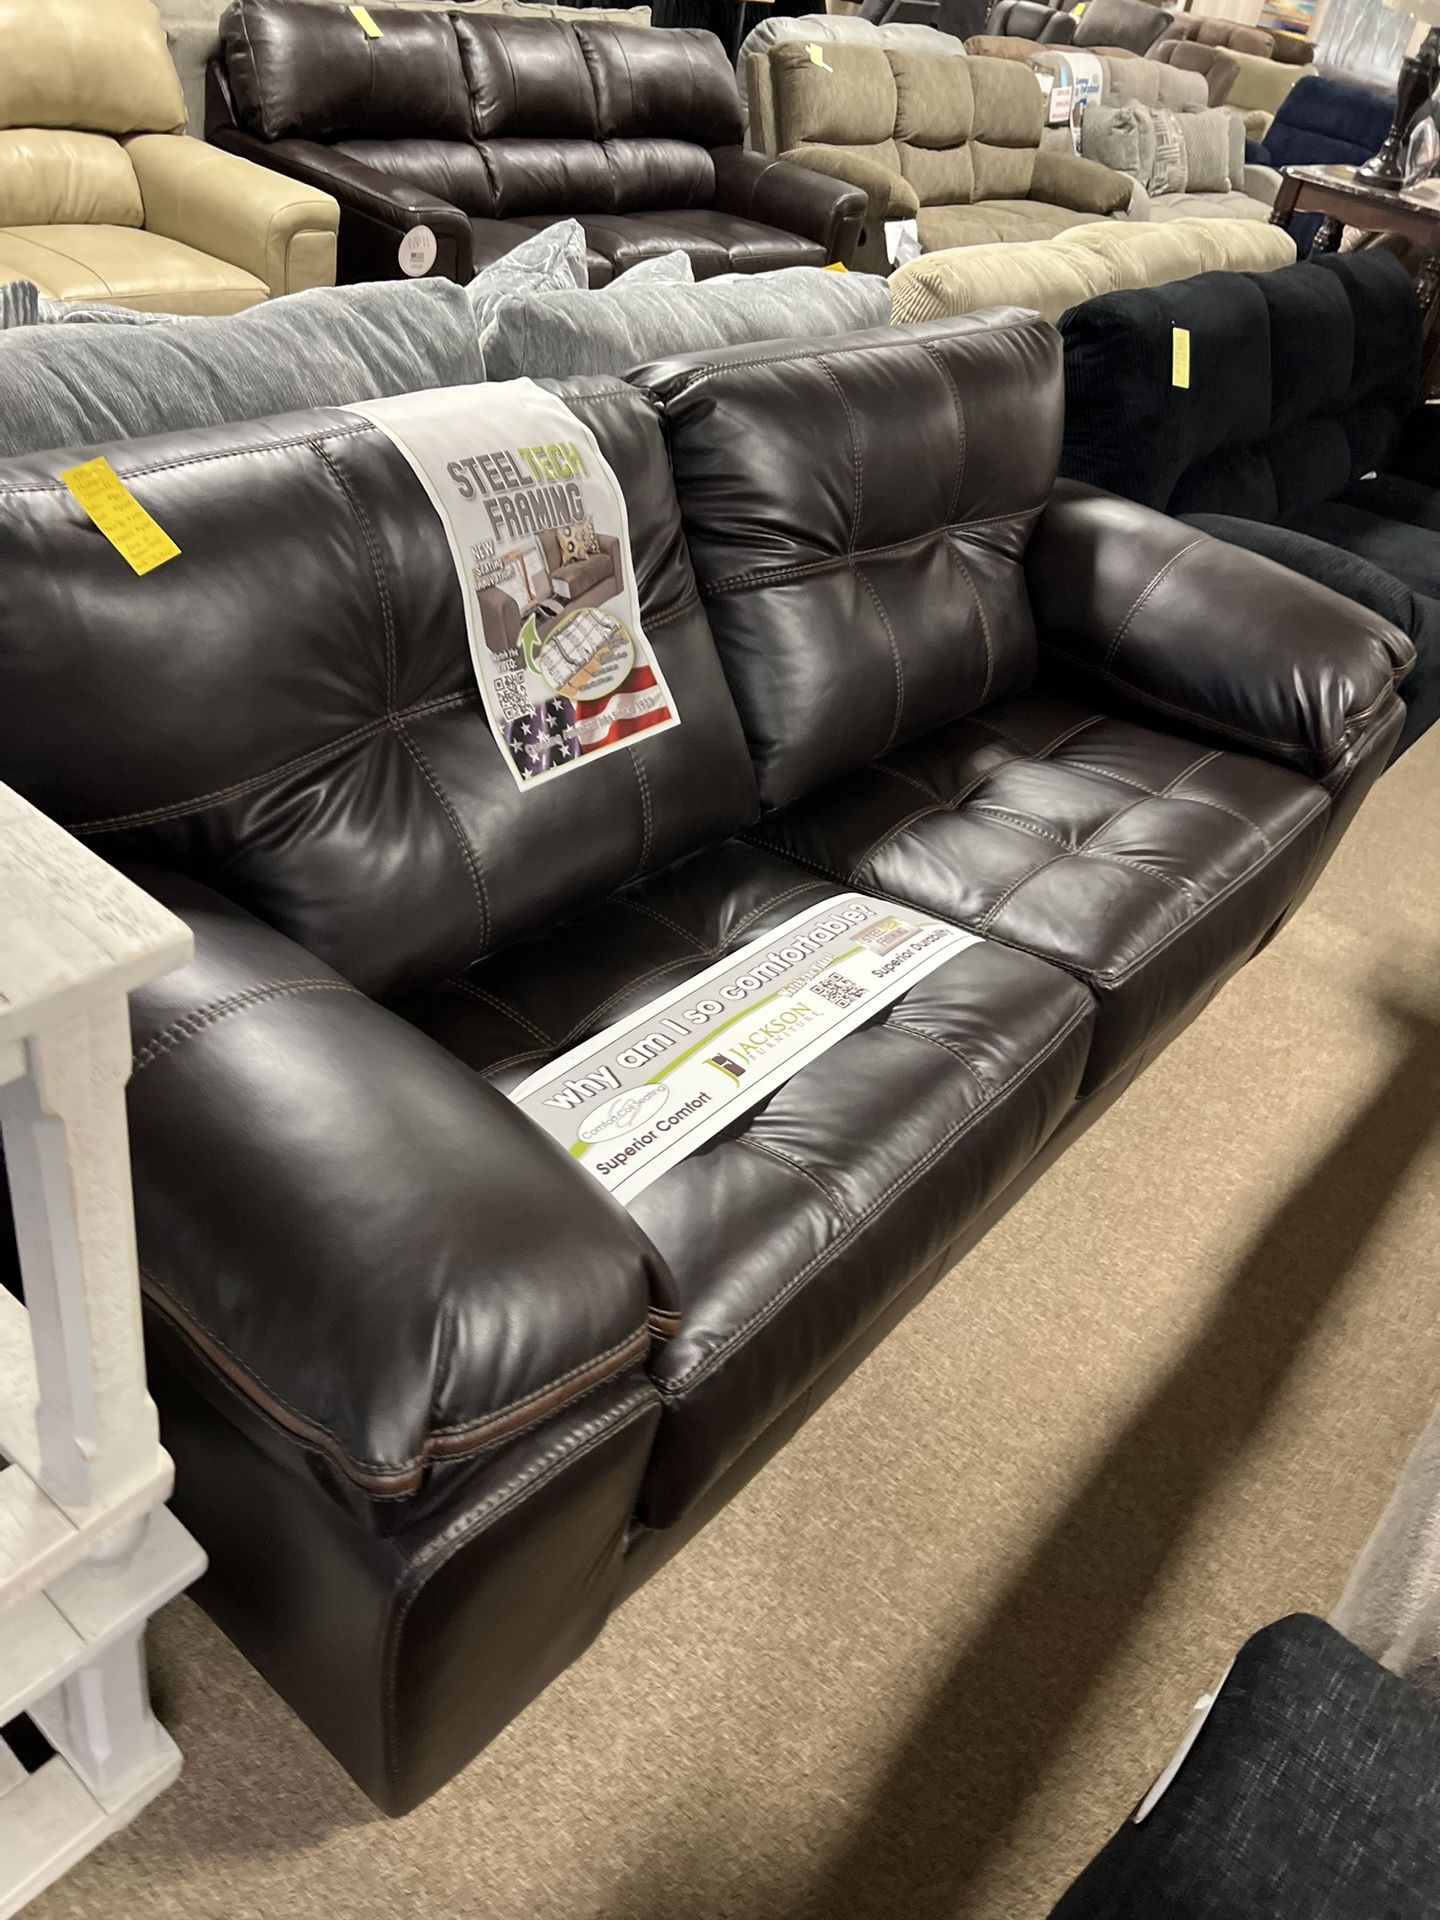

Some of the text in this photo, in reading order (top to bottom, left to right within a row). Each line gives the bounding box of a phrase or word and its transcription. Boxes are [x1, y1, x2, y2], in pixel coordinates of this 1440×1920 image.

[483, 482, 585, 541] FRAMING
[471, 539, 495, 560] NEW
[871, 928, 954, 978] Superior Durability
[543, 1065, 622, 1110] why
[616, 1033, 676, 1068] am
[661, 1015, 692, 1037] I
[683, 1000, 724, 1024] so
[719, 903, 877, 1001] comfortable?
[729, 1002, 812, 1065] JACKSON
[582, 1084, 667, 1140] Comfort Coil Seating
[596, 1091, 712, 1175] Superior Comfort
